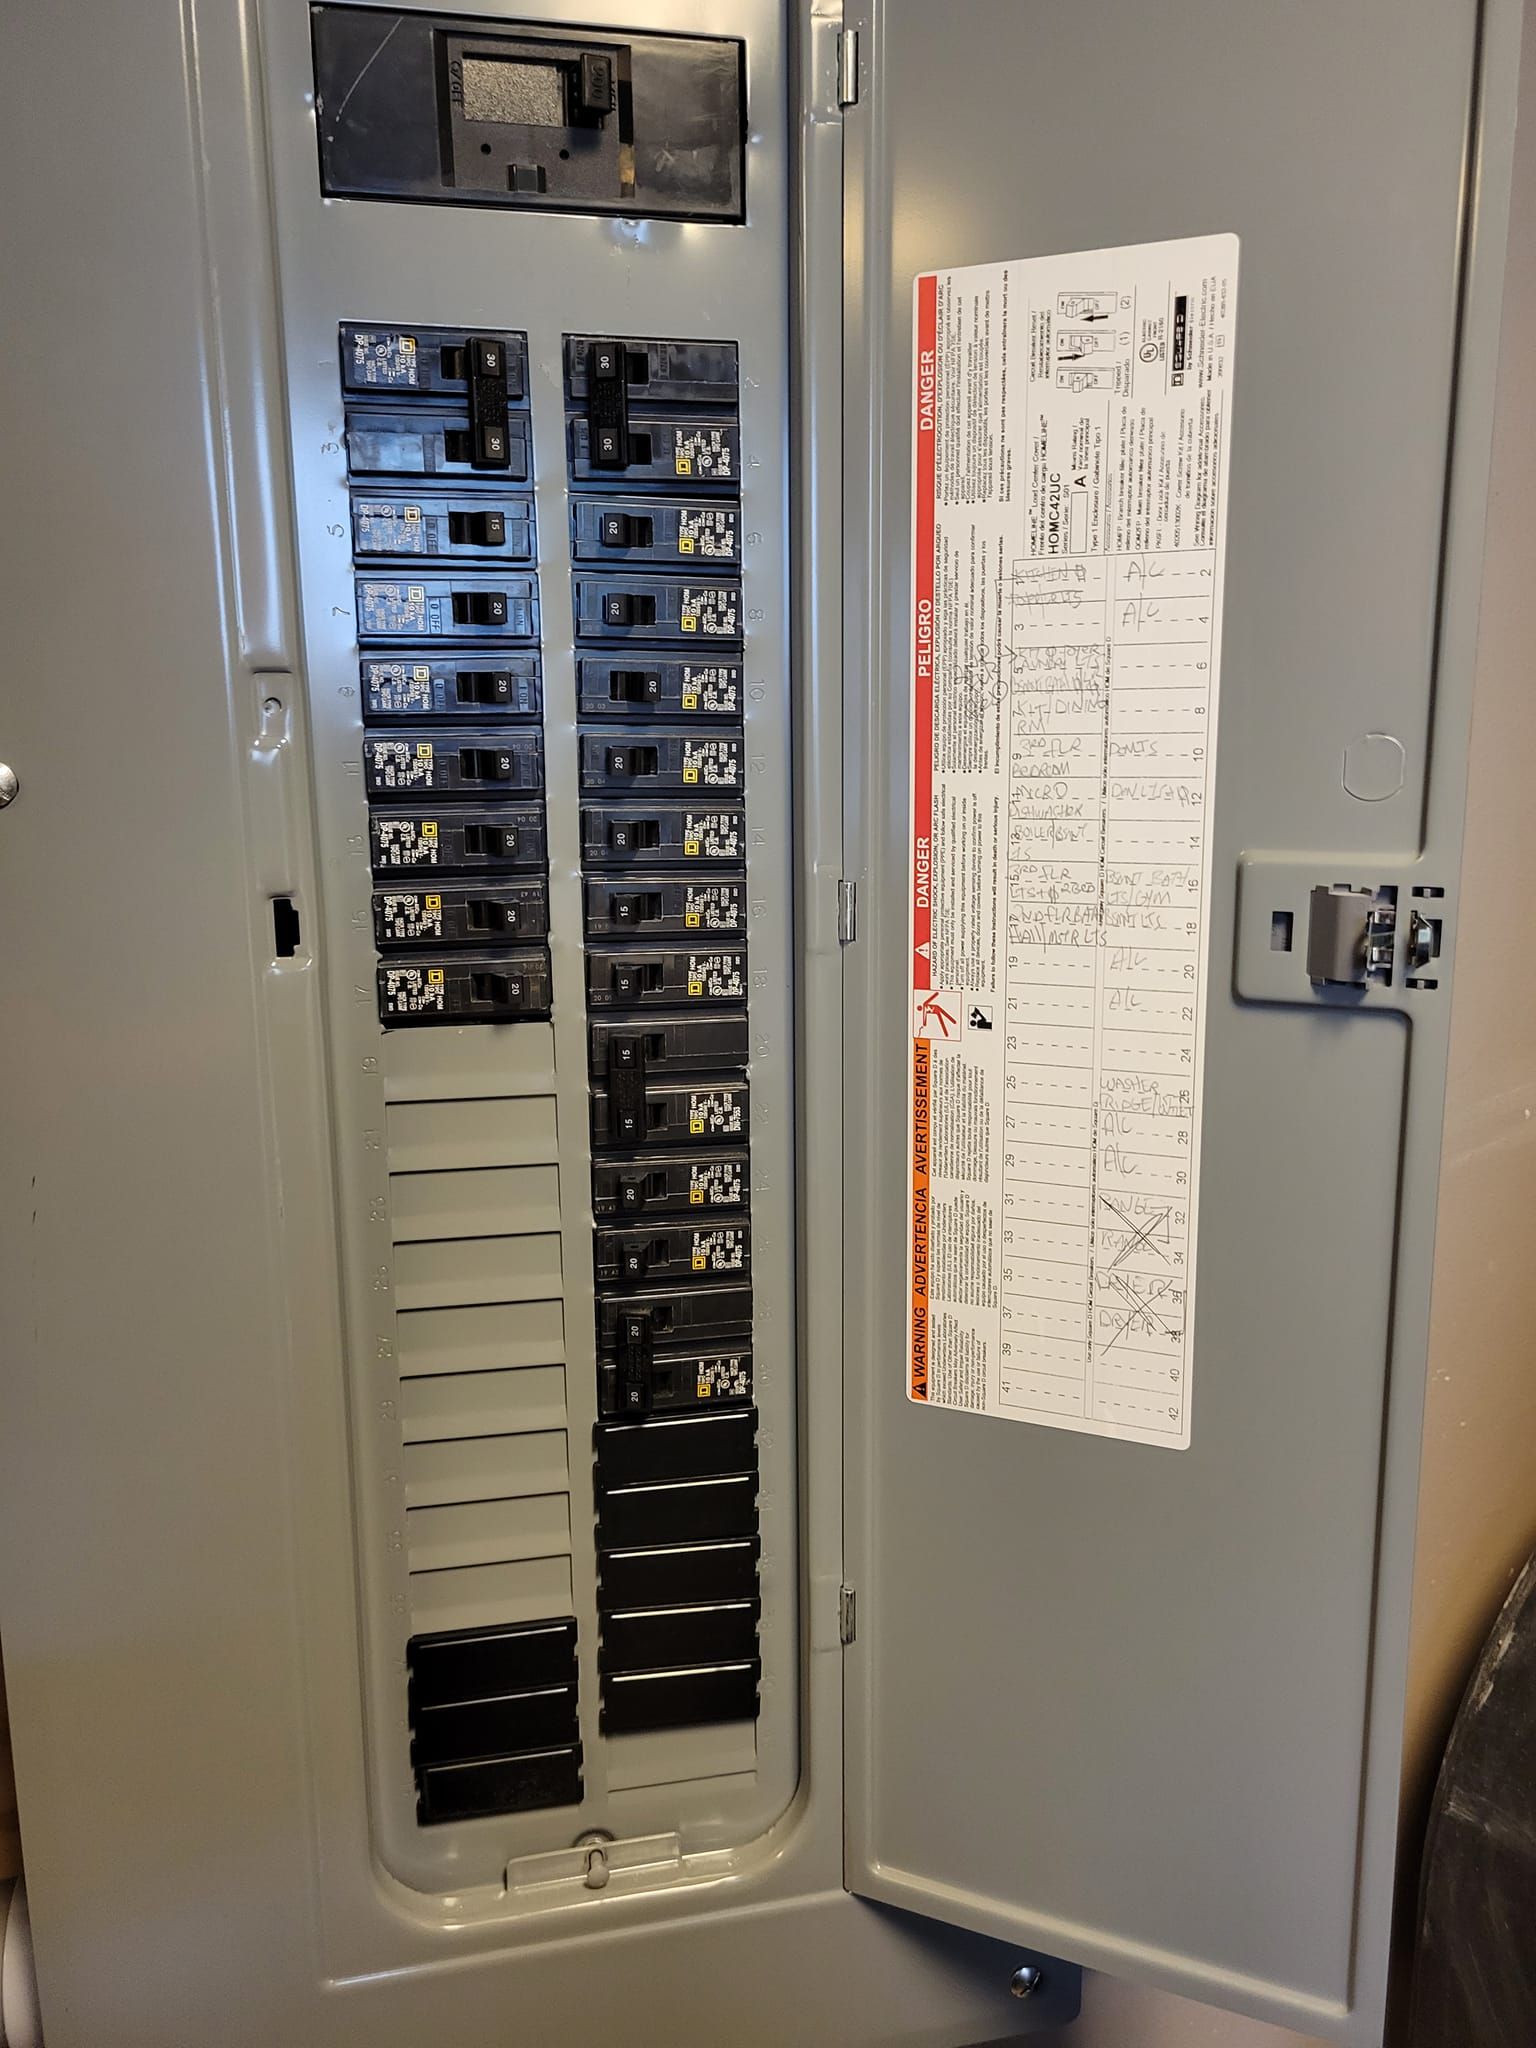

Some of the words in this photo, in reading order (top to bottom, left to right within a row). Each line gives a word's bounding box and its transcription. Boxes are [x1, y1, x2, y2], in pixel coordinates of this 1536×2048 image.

[1121, 296, 1131, 309] (2)
[1120, 332, 1130, 345] (1)
[937, 343, 943, 352] OU
[487, 354, 495, 367] 30
[601, 356, 609, 369] 30
[1122, 359, 1130, 397] Disparado
[920, 350, 934, 431] DANGER
[492, 438, 500, 450] 30
[604, 438, 612, 451] 30
[1094, 432, 1102, 448] Tipo
[1074, 476, 1086, 487] A
[1040, 486, 1046, 496] de
[1048, 473, 1061, 553] HOMC42UC
[491, 518, 500, 530] 15
[609, 522, 618, 534] 20
[726, 531, 734, 556] DP-4075
[1091, 535, 1099, 552] Type
[494, 602, 502, 615] 20
[611, 602, 619, 615] 20
[918, 599, 931, 677] PELIGRO
[1196, 662, 1207, 670] 6
[370, 665, 380, 692] DP-4075
[498, 680, 507, 692] 20
[649, 681, 657, 692] 20
[1194, 707, 1205, 715] 8
[934, 732, 940, 741] DE
[374, 743, 384, 769] DP-4075
[1193, 748, 1204, 761] 10
[501, 758, 509, 769] 20
[615, 757, 623, 769] 20
[1012, 792, 1021, 804] 11
[1191, 793, 1202, 806] 12
[380, 822, 389, 848] DP-4075
[506, 835, 514, 846] 20
[617, 833, 625, 845] 20
[933, 832, 938, 841] OR
[1011, 833, 1020, 845] 13
[1190, 836, 1200, 849] 14
[916, 837, 930, 908] DANGER
[1010, 875, 1019, 887] 15
[1188, 879, 1199, 893] 16
[384, 896, 393, 921] DP-4075
[621, 906, 628, 917] 15
[507, 910, 515, 922] 20
[1009, 916, 1018, 927] 17
[1187, 923, 1196, 936] 18
[933, 941, 938, 951] OF
[1009, 956, 1018, 968] 19
[1185, 965, 1194, 979] 20
[387, 971, 396, 995] DP-4075
[512, 983, 519, 995] 20
[621, 979, 629, 990] 15
[1008, 998, 1017, 1010] 21
[1183, 1007, 1193, 1021] 22
[1007, 1036, 1016, 1050] 23
[623, 1049, 630, 1060] 15
[1181, 1049, 1191, 1063] 24
[1007, 1075, 1016, 1089] 25
[1179, 1090, 1189, 1104] 26
[916, 1043, 927, 1175] AVERTISSEMENT
[625, 1119, 633, 1129] 15
[1006, 1115, 1015, 1128] 27
[1178, 1131, 1188, 1144] 28
[1006, 1154, 1014, 1167] 29
[1177, 1171, 1186, 1184] 30
[627, 1189, 634, 1200] 20
[1004, 1192, 1013, 1206] 31
[1175, 1211, 1185, 1224] 32
[914, 1188, 927, 1297] ADVERTENCIA
[1004, 1230, 1013, 1244] 33
[630, 1258, 637, 1269] 20
[1174, 1251, 1183, 1264] 34
[1003, 1268, 1012, 1281] 35
[1003, 1306, 1012, 1319] 37
[632, 1326, 639, 1336] 20
[914, 1306, 926, 1378] WARNING
[1002, 1343, 1011, 1356] 39
[1170, 1368, 1179, 1382] 40
[1002, 1380, 1010, 1393] 41
[631, 1392, 638, 1402] 20
[1169, 1407, 1179, 1420] 42
